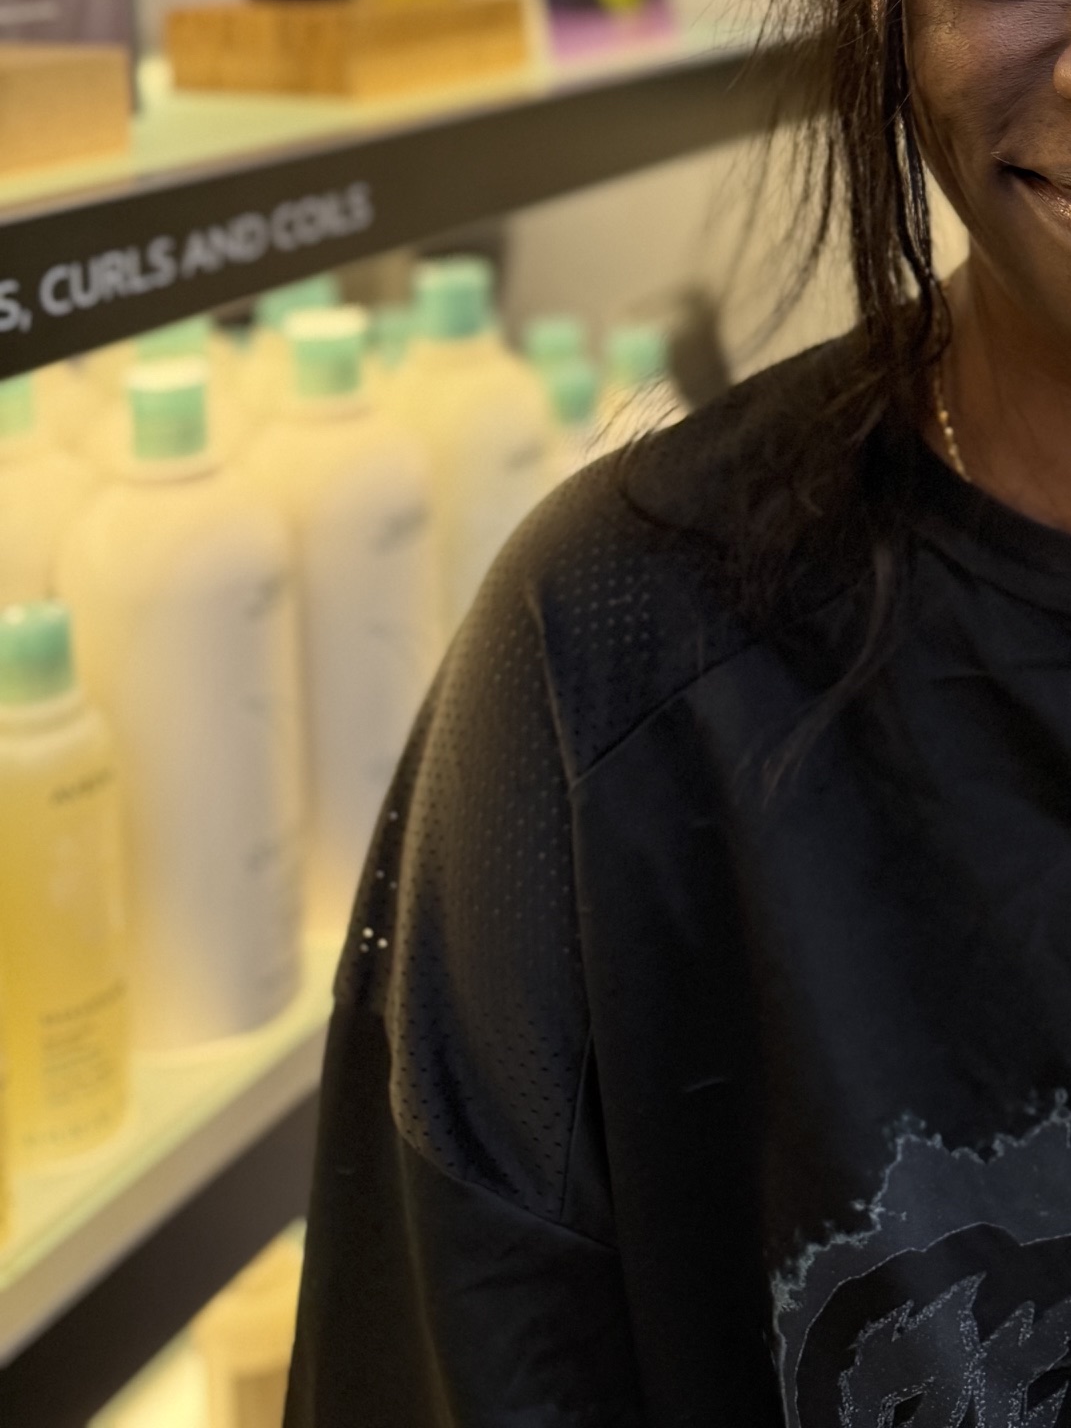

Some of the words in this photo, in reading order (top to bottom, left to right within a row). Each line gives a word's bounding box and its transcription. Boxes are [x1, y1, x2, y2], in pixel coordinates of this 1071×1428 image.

[38, 235, 177, 317] CURLS
[181, 212, 268, 278] AND
[269, 181, 375, 250] COILS
